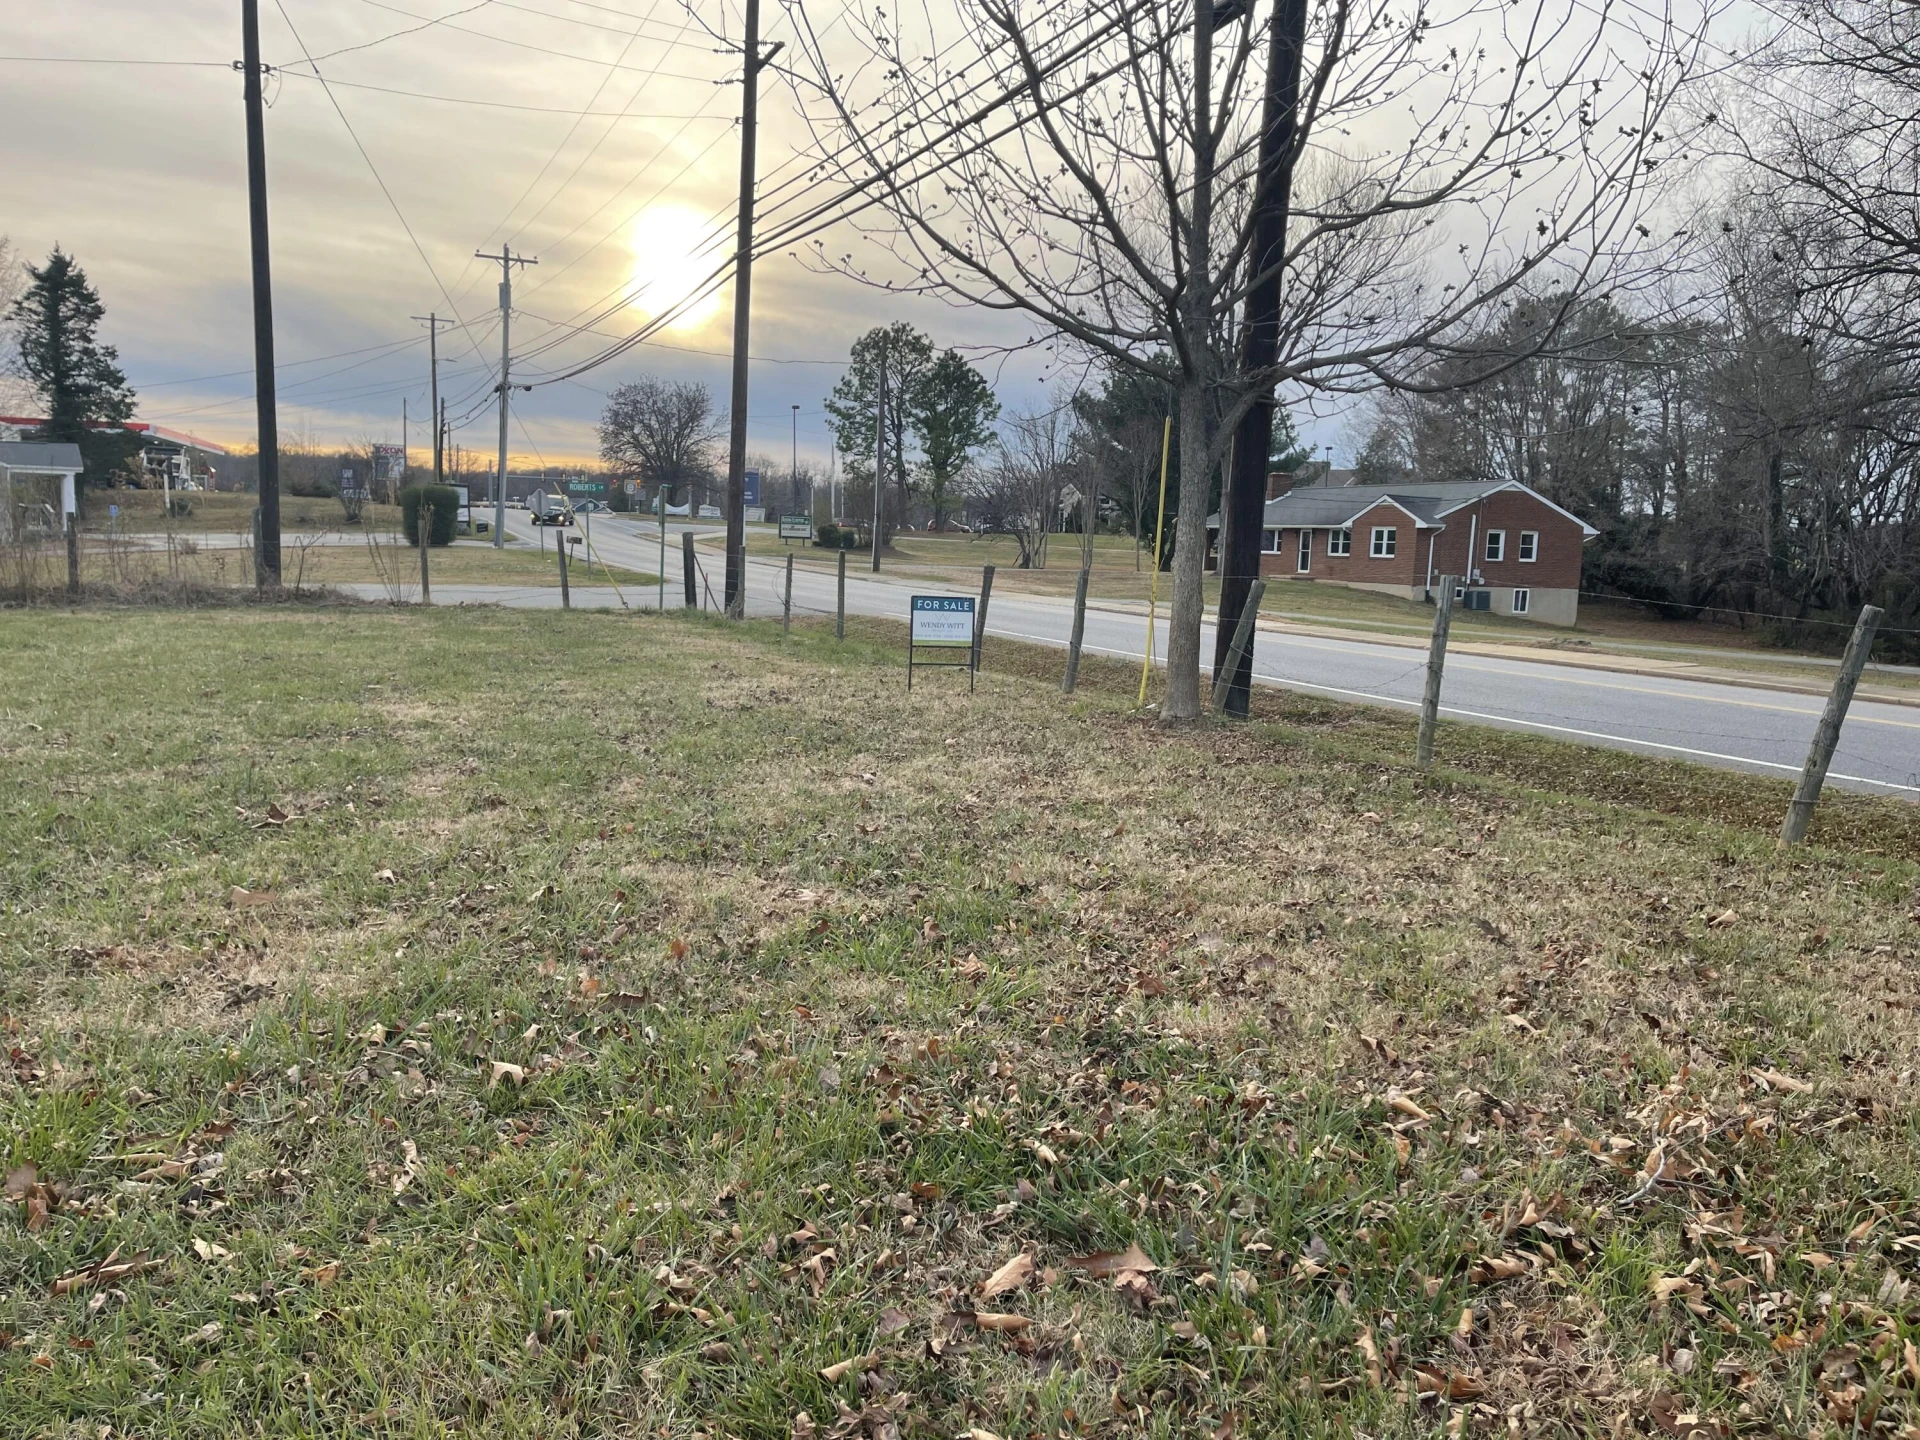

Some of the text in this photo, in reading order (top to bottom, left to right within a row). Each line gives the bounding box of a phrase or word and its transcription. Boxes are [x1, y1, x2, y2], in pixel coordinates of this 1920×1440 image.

[377, 445, 403, 455] XXON
[569, 483, 596, 491] ROBERTS
[918, 600, 970, 610] FOR SALE
